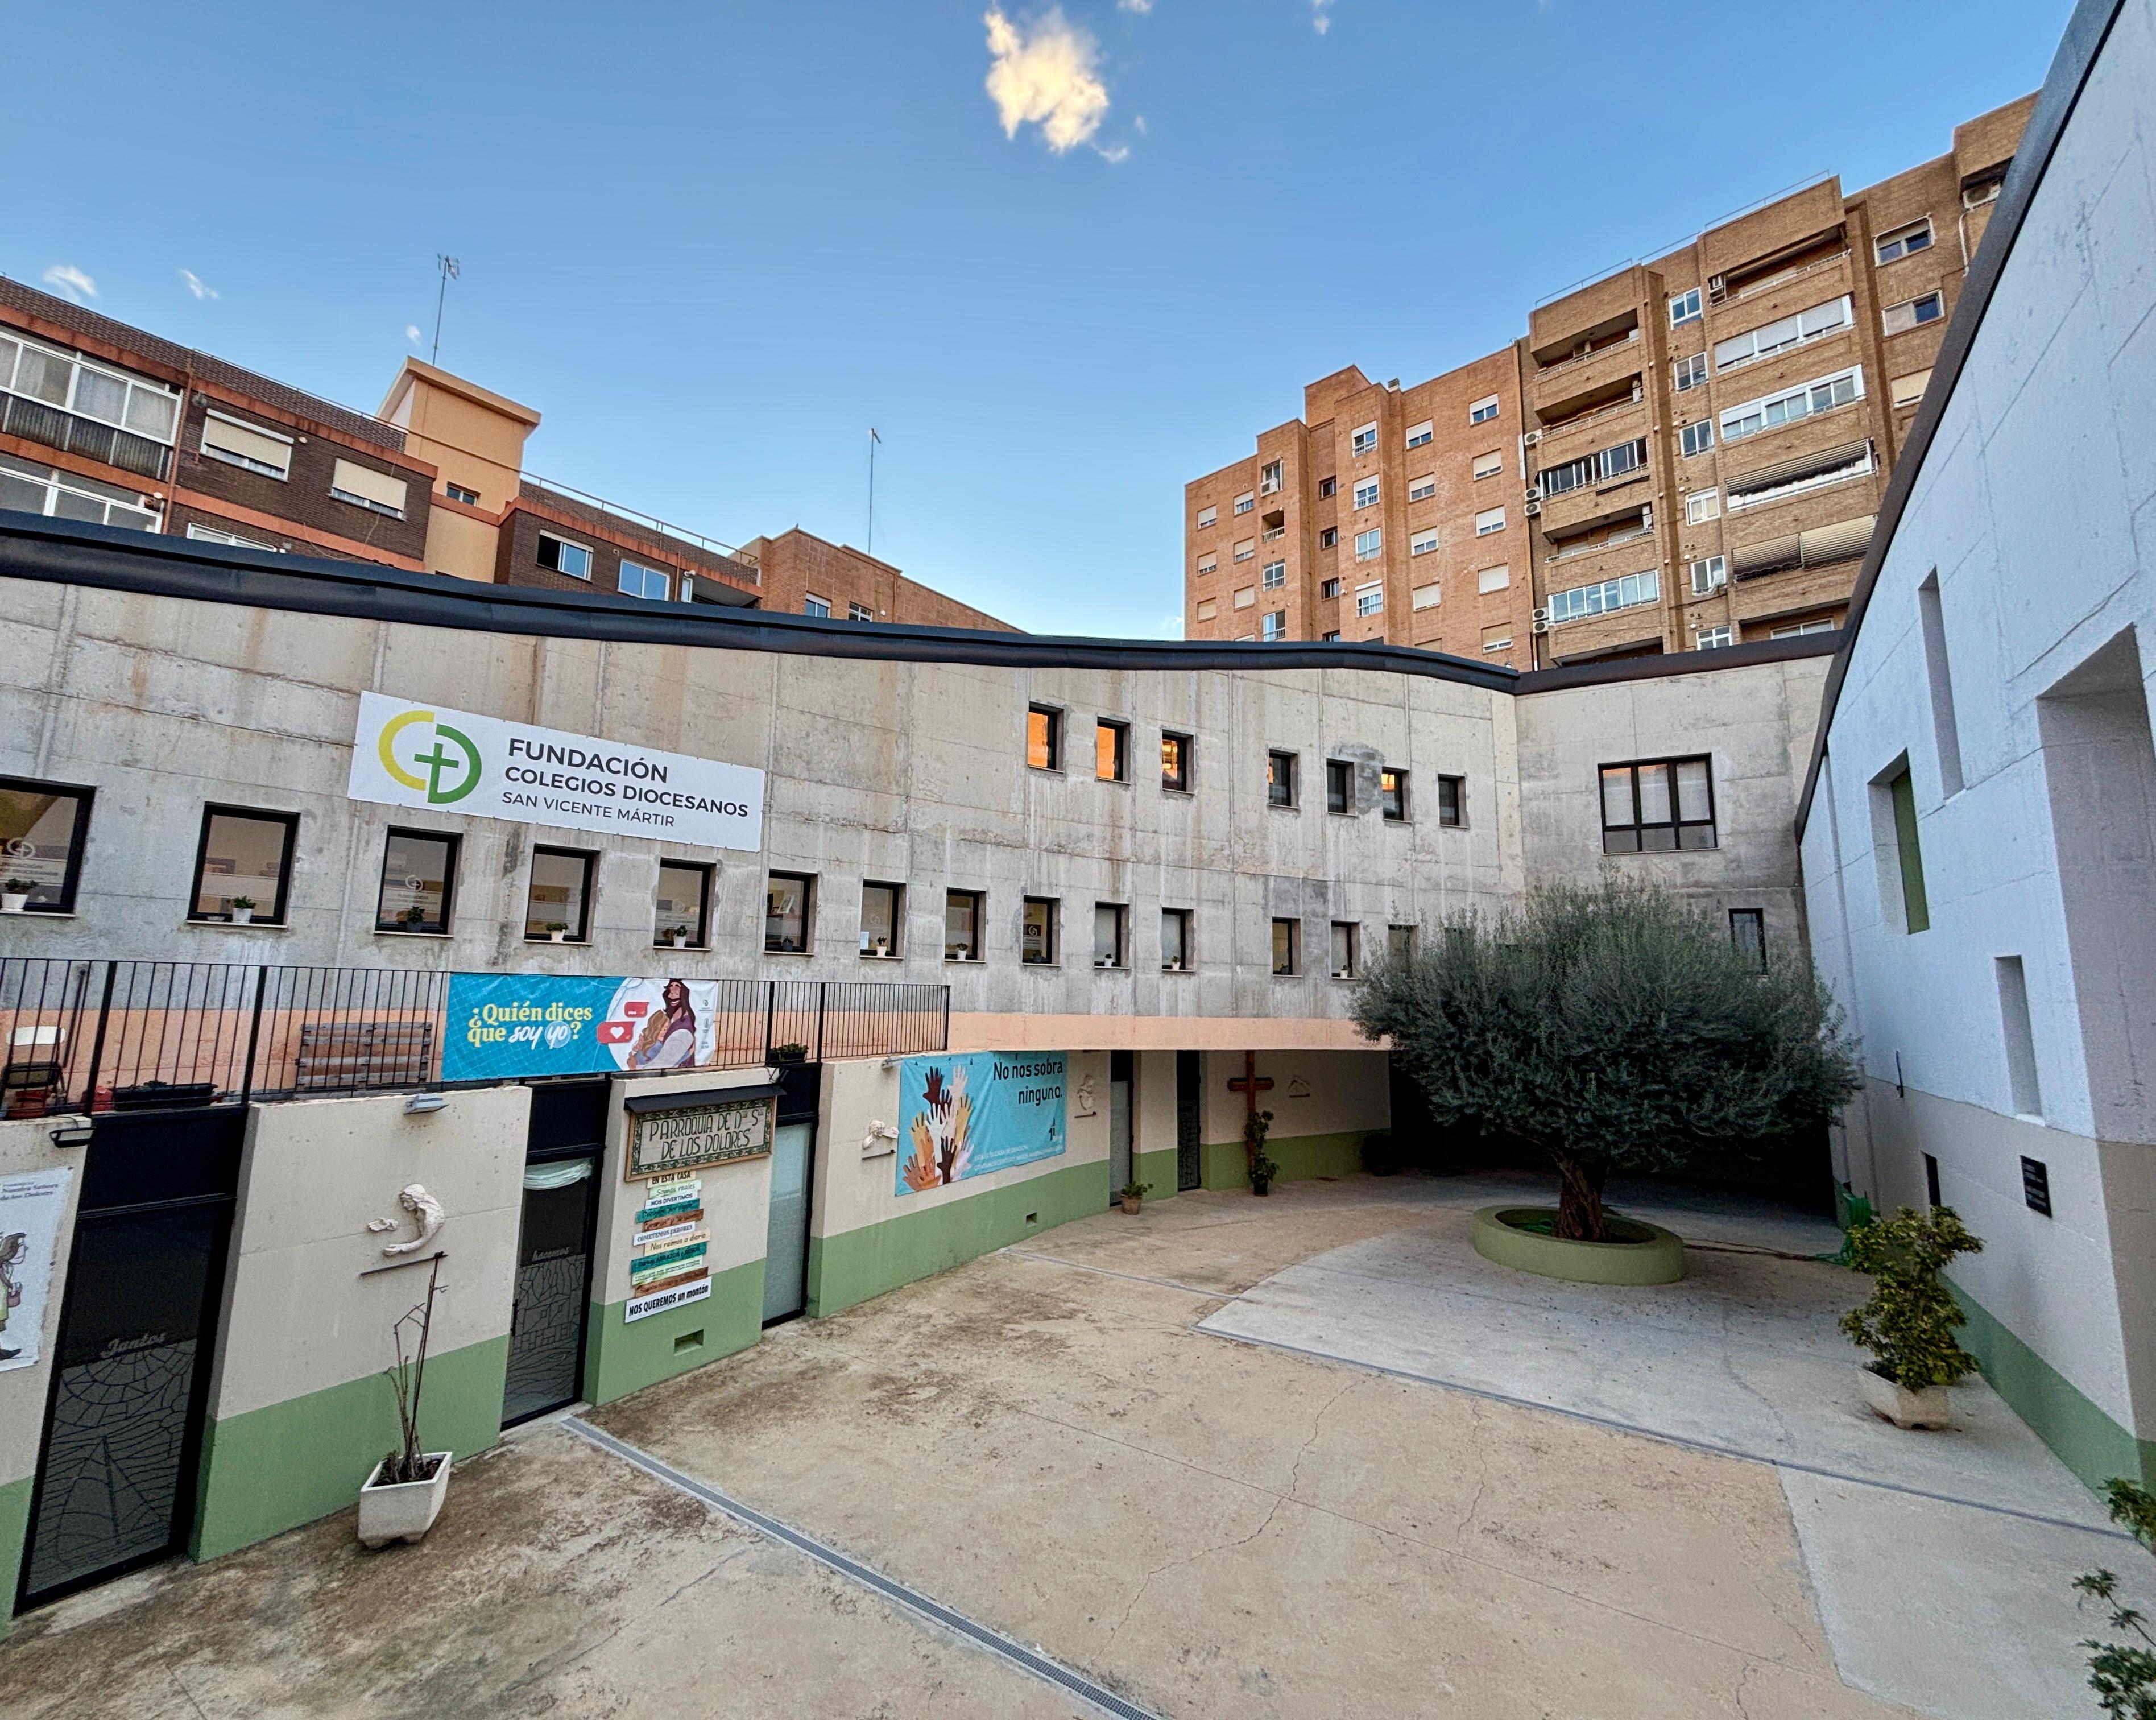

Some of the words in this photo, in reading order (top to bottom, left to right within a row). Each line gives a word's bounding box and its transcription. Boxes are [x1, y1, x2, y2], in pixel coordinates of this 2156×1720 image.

[508, 738, 668, 783] FUNDACIÓN
[504, 766, 616, 797] COLEGIOS
[623, 785, 749, 818] DIOCESANOS
[502, 791, 537, 808] SAN
[544, 798, 613, 819] VICENTE
[618, 804, 676, 828] MÁRTIR
[468, 1000, 542, 1028] ¿Quién
[545, 1002, 593, 1022] dices
[467, 1026, 506, 1047] que
[508, 1027, 544, 1050] soy
[994, 1061, 1009, 1081] No
[1012, 1064, 1032, 1079] nos
[1034, 1058, 1063, 1077] sobra
[1019, 1085, 1062, 1106] ninguno.
[650, 1115, 713, 1142] PARROQUIA
[717, 1113, 730, 1131] DE
[661, 1140, 677, 1160] DE
[680, 1136, 700, 1157] LOS
[705, 1128, 751, 1153] DOLORES
[661, 1173, 675, 1183] ESTA
[677, 1171, 690, 1180] CASA
[663, 1193, 693, 1204] DIVERTIMOS
[650, 1242, 662, 1251] Nos
[628, 1303, 642, 1317] NOS
[643, 1292, 677, 1312] QUEREMOS
[677, 1292, 685, 1301] un
[686, 1283, 709, 1299] montón
